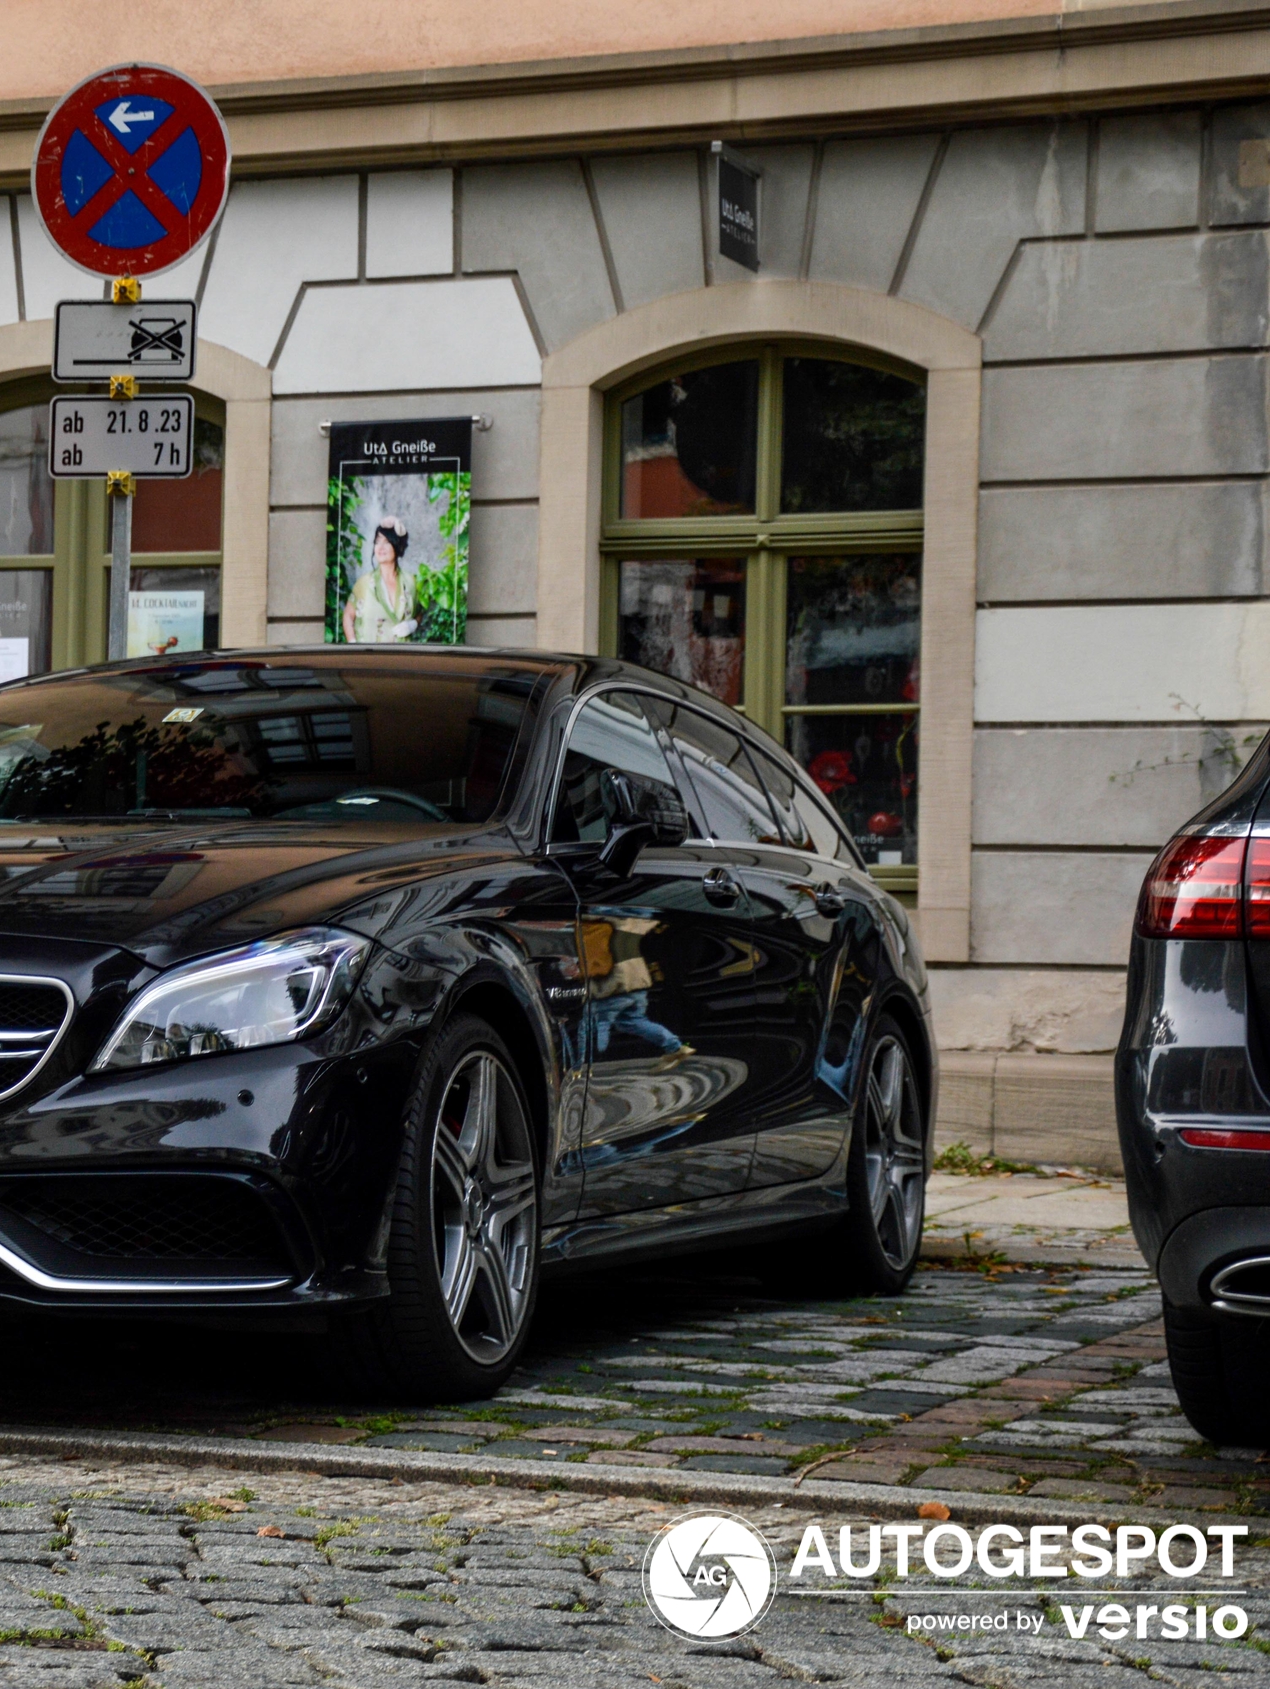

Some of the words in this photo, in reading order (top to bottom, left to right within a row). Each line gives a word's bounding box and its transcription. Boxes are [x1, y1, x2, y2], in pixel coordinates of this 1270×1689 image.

[63, 411, 83, 433] ab
[62, 444, 82, 466] ab
[392, 439, 436, 454] Gneiße
[373, 455, 427, 464] ATELIER
